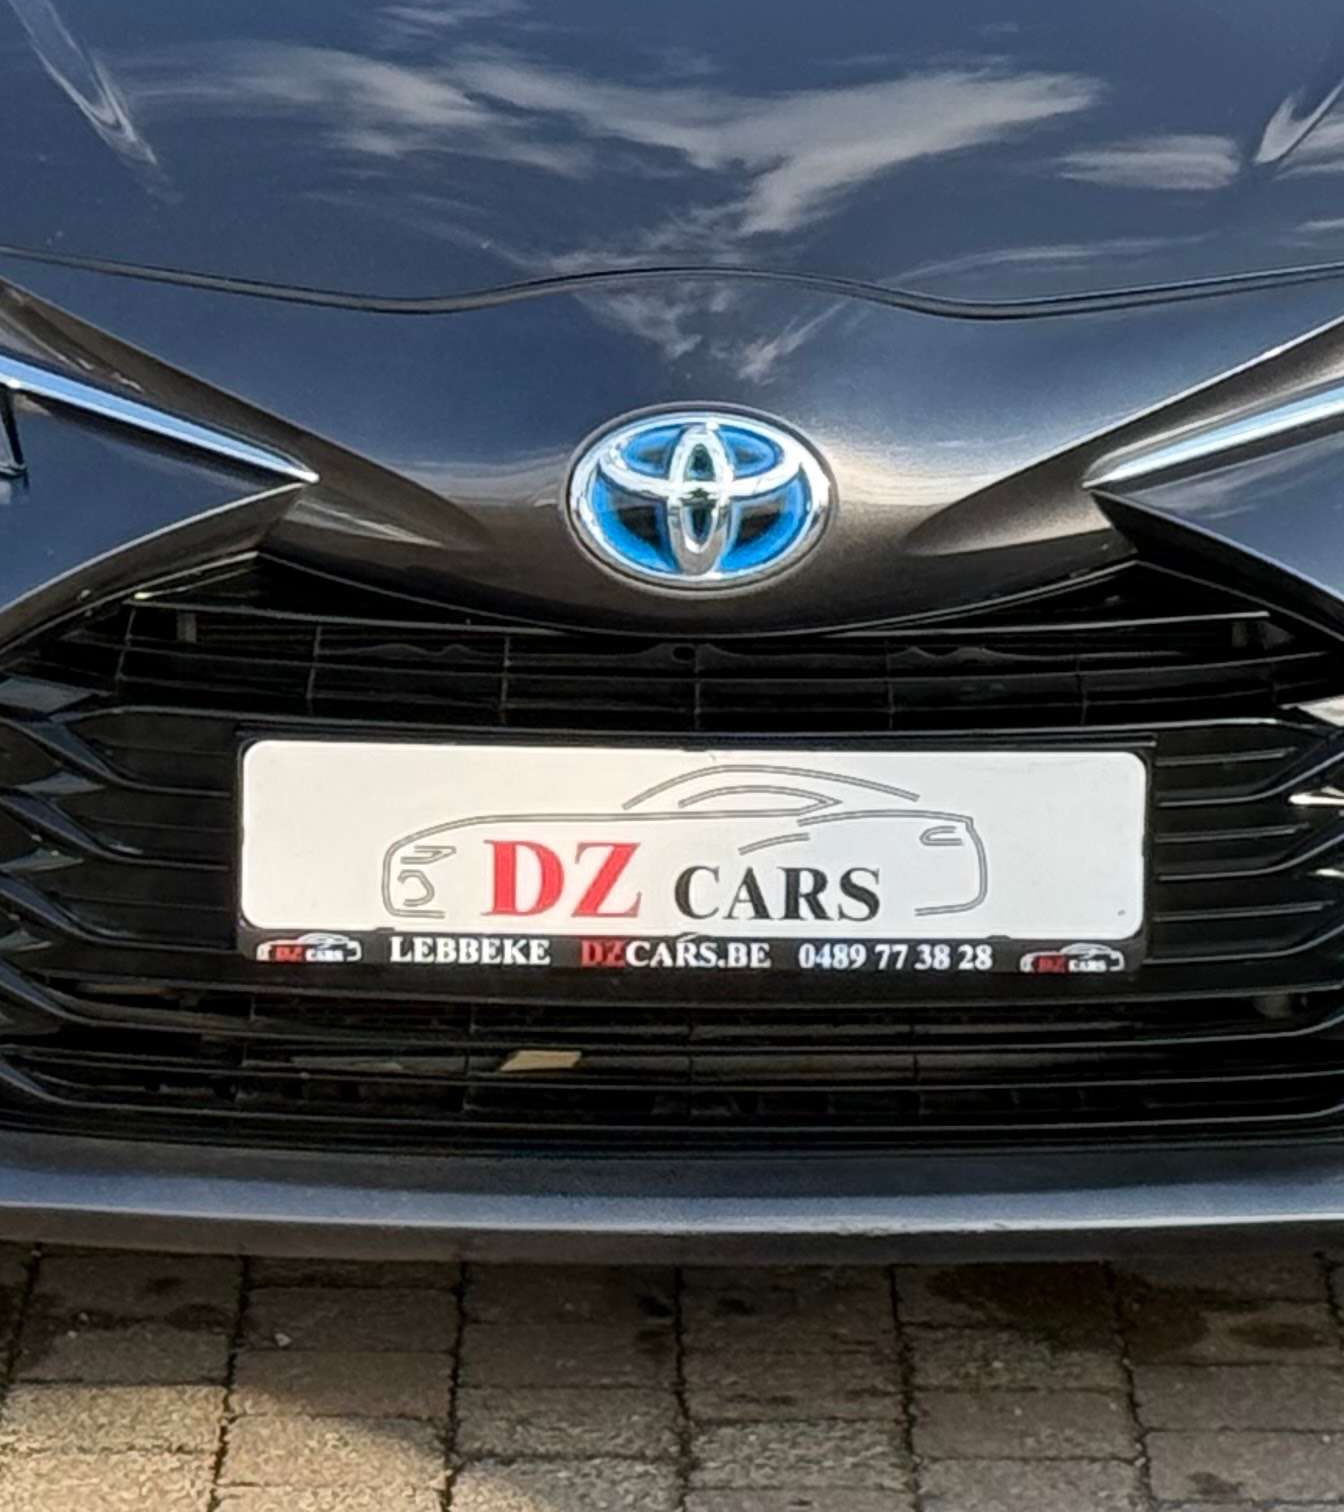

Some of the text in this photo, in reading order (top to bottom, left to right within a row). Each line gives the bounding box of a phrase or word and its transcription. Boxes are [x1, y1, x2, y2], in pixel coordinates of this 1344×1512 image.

[480, 840, 881, 922] DZ CARS
[389, 936, 551, 966] LEBBEKE
[798, 941, 866, 970] 0489
[874, 943, 907, 970] 77
[914, 943, 952, 971] 38
[958, 944, 994, 971] 28
